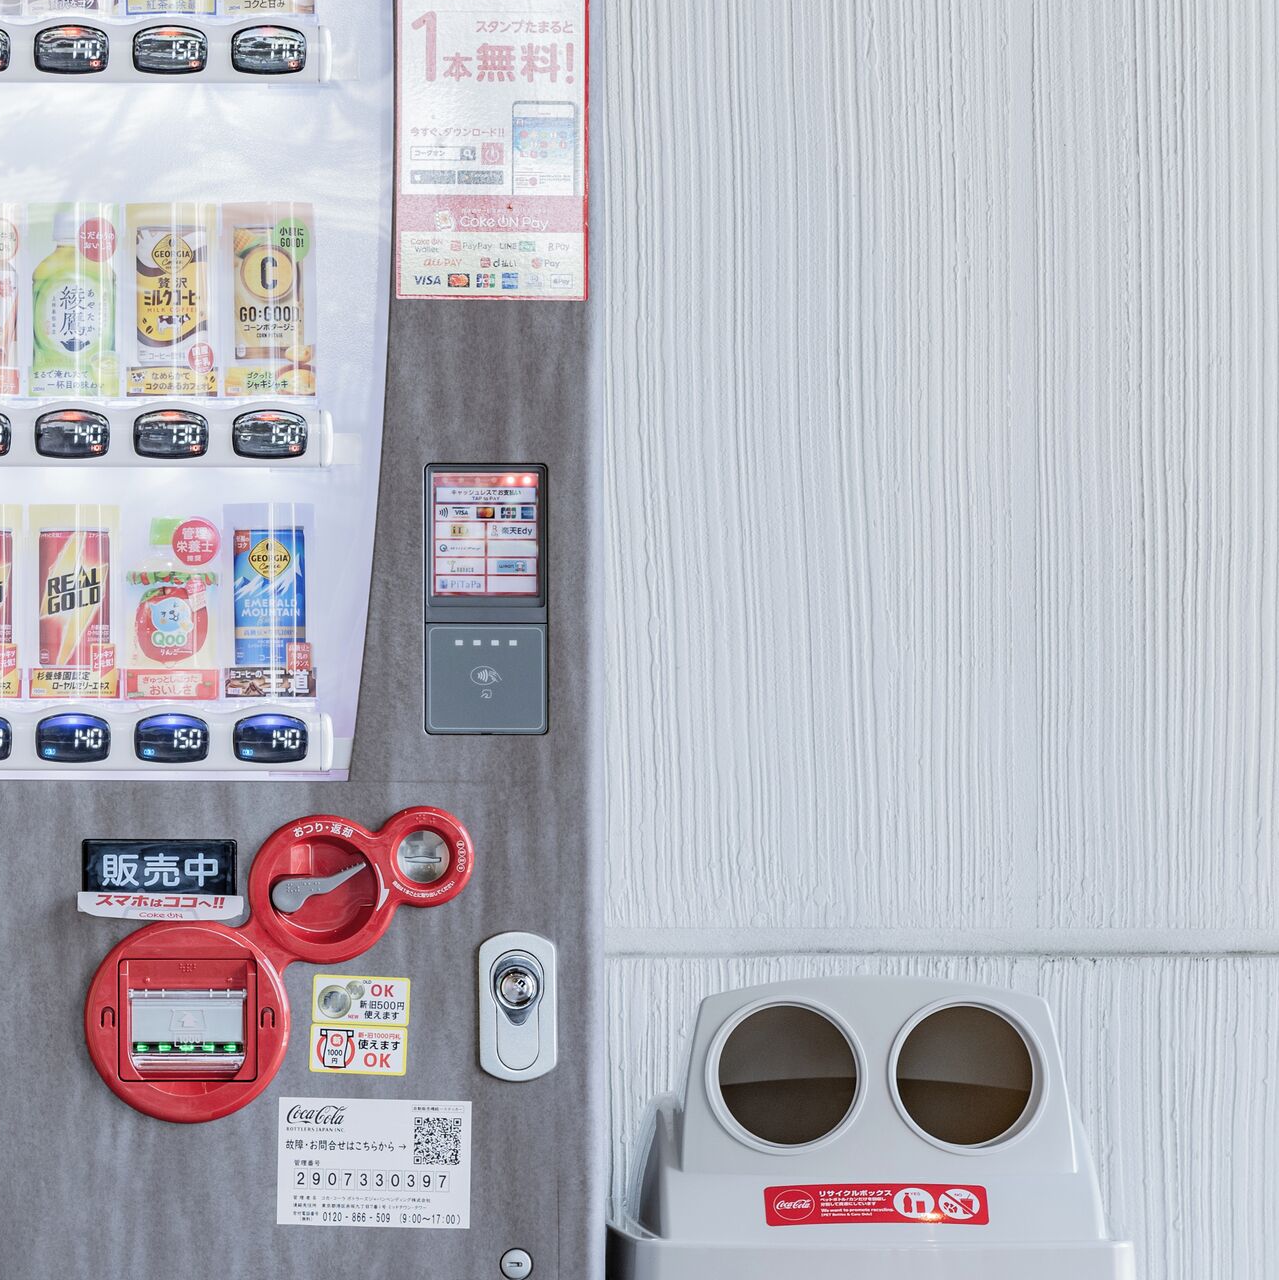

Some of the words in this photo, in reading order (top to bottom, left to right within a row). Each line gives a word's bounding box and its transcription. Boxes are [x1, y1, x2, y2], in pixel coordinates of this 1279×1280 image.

[476, 20, 574, 34] スタンプたまると
[411, 10, 574, 85] 1本無料!
[410, 127, 505, 137] 今すぐ、ダウンロード!!
[460, 215, 496, 228] Coke
[497, 214, 519, 227] ON
[522, 216, 549, 231] Pay
[462, 243, 493, 252] PayPay
[260, 256, 278, 290] C
[414, 275, 442, 285] VISA
[246, 380, 289, 389] シャキシャキ
[73, 423, 102, 444] 140
[171, 423, 200, 444] 130
[270, 423, 299, 444] 150
[177, 540, 214, 553] 栄養士
[251, 554, 289, 562] GEORGIA
[47, 566, 101, 596] REAL
[450, 580, 482, 589] PiTaPa
[47, 586, 101, 615] GOLD
[244, 598, 298, 608] EMERALD
[241, 608, 301, 617] MOUNTAIN
[151, 631, 187, 647] Qoo
[149, 684, 192, 695] おいしさ
[73, 728, 102, 748] 140
[172, 728, 201, 748] 150
[270, 728, 300, 748] 140
[292, 822, 354, 839] おつり・返却
[102, 852, 219, 887] 販売中
[96, 894, 226, 909] スマホはココへ!!
[139, 911, 165, 919] Coke
[370, 984, 395, 997] OK
[364, 1011, 400, 1020] 使えます
[358, 1039, 401, 1050] 使えます
[363, 1052, 392, 1068] OK
[286, 1104, 349, 1126] Coca-Cola
[285, 1139, 395, 1151] 故障・お問合せはこちらから
[293, 1159, 321, 1167] 管理番号
[818, 1189, 893, 1197] リサイクルボックス
[776, 1200, 812, 1210] Coca-Cola
